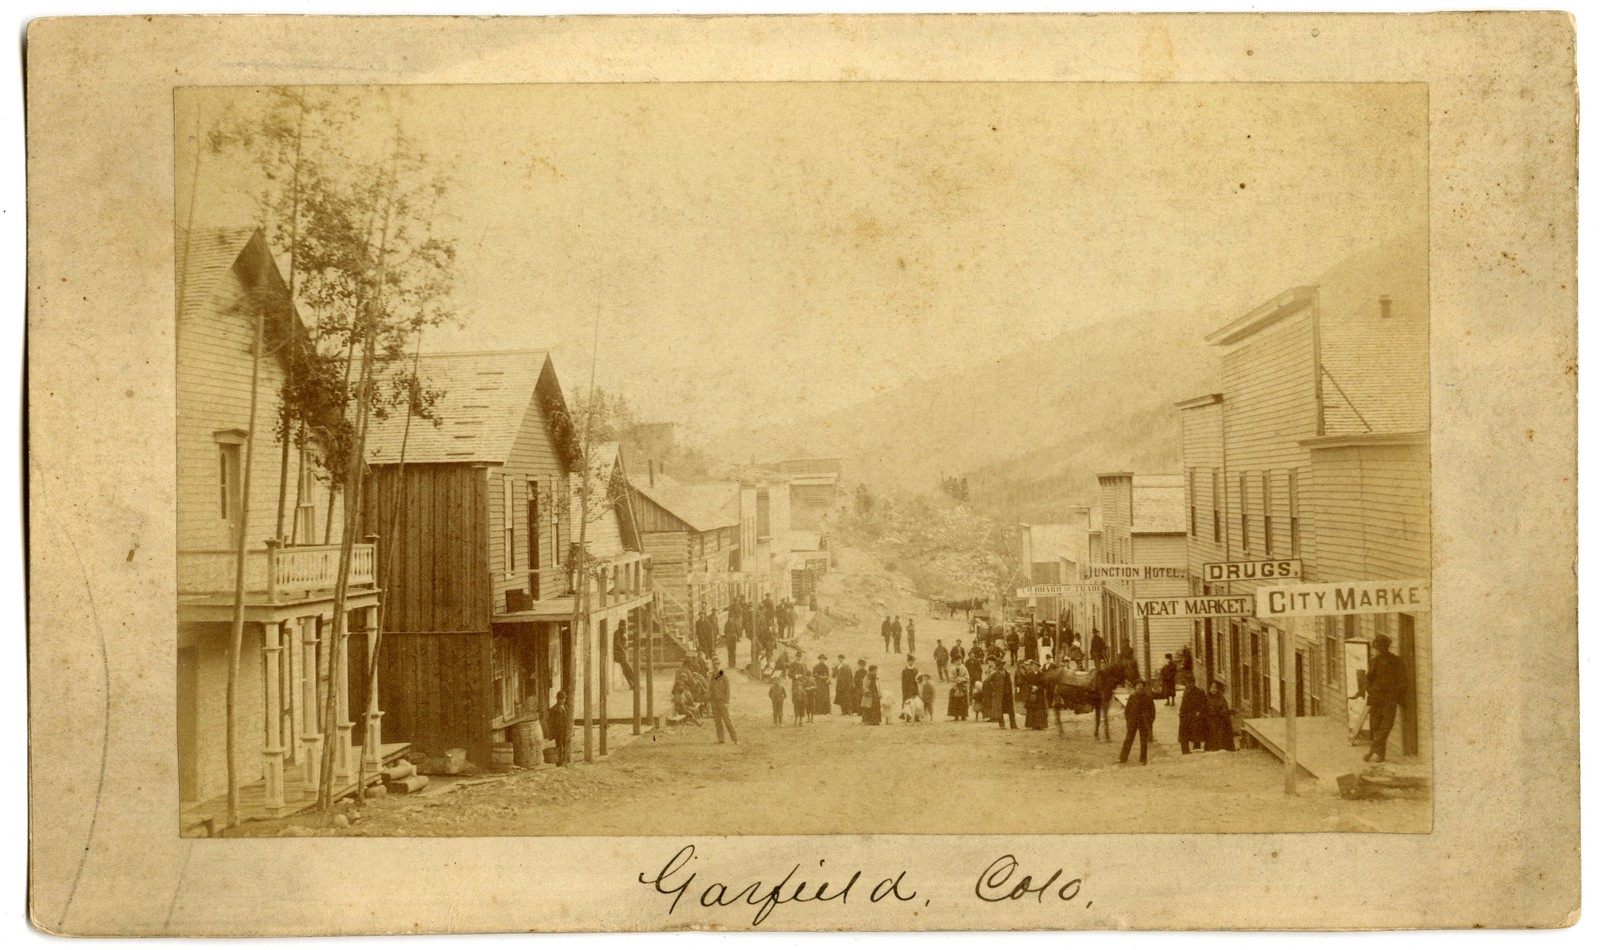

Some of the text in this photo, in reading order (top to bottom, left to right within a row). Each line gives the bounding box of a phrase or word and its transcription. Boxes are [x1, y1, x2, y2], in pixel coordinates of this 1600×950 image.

[1136, 599, 1250, 616] MEAT MARKET.
[1335, 587, 1430, 611] MARKE
